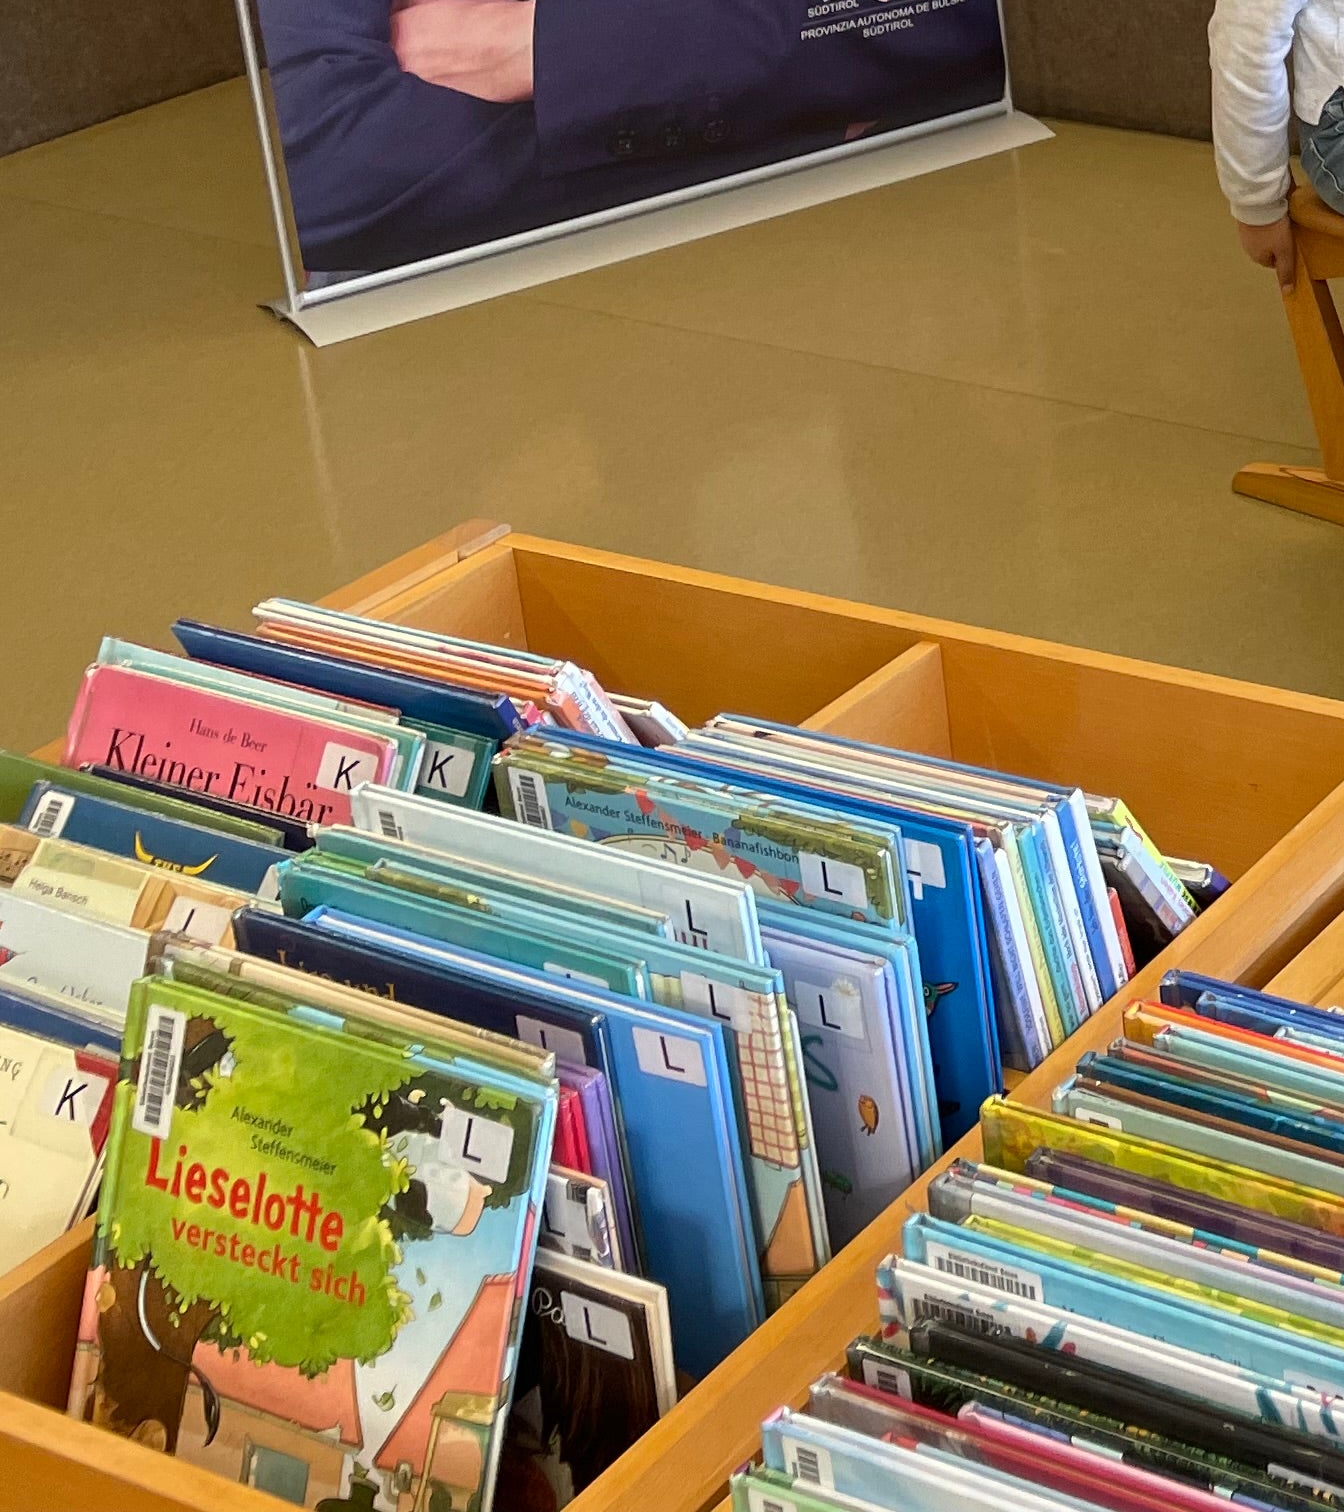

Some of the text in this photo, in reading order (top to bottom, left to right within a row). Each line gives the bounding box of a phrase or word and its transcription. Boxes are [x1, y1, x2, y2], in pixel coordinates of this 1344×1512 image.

[800, 19, 857, 41] PROVINZIA
[857, 4, 915, 29] AUTONOMA
[916, 1, 930, 14] DE
[807, 0, 860, 19] SÜDTIROL
[862, 18, 914, 39] SÜDTIROL
[189, 717, 268, 754] Hans de Beer
[105, 727, 336, 828] Kleiner Eisbär
[333, 754, 363, 793] K
[427, 749, 455, 790] K
[565, 795, 620, 822] Alexander
[712, 830, 801, 866] Bananafishbon
[28, 877, 53, 895] Helga
[820, 860, 844, 896] L
[685, 899, 708, 936] L
[708, 983, 731, 1021] L
[820, 993, 843, 1030] L
[659, 1035, 686, 1073] L
[54, 1078, 89, 1121] K
[231, 1105, 295, 1138] Alexander
[462, 1116, 482, 1163] L
[250, 1133, 337, 1176] Steffensmeier
[145, 1136, 344, 1253] Lieselotte
[171, 1217, 367, 1307] versteckt sich
[585, 1306, 609, 1342] L
